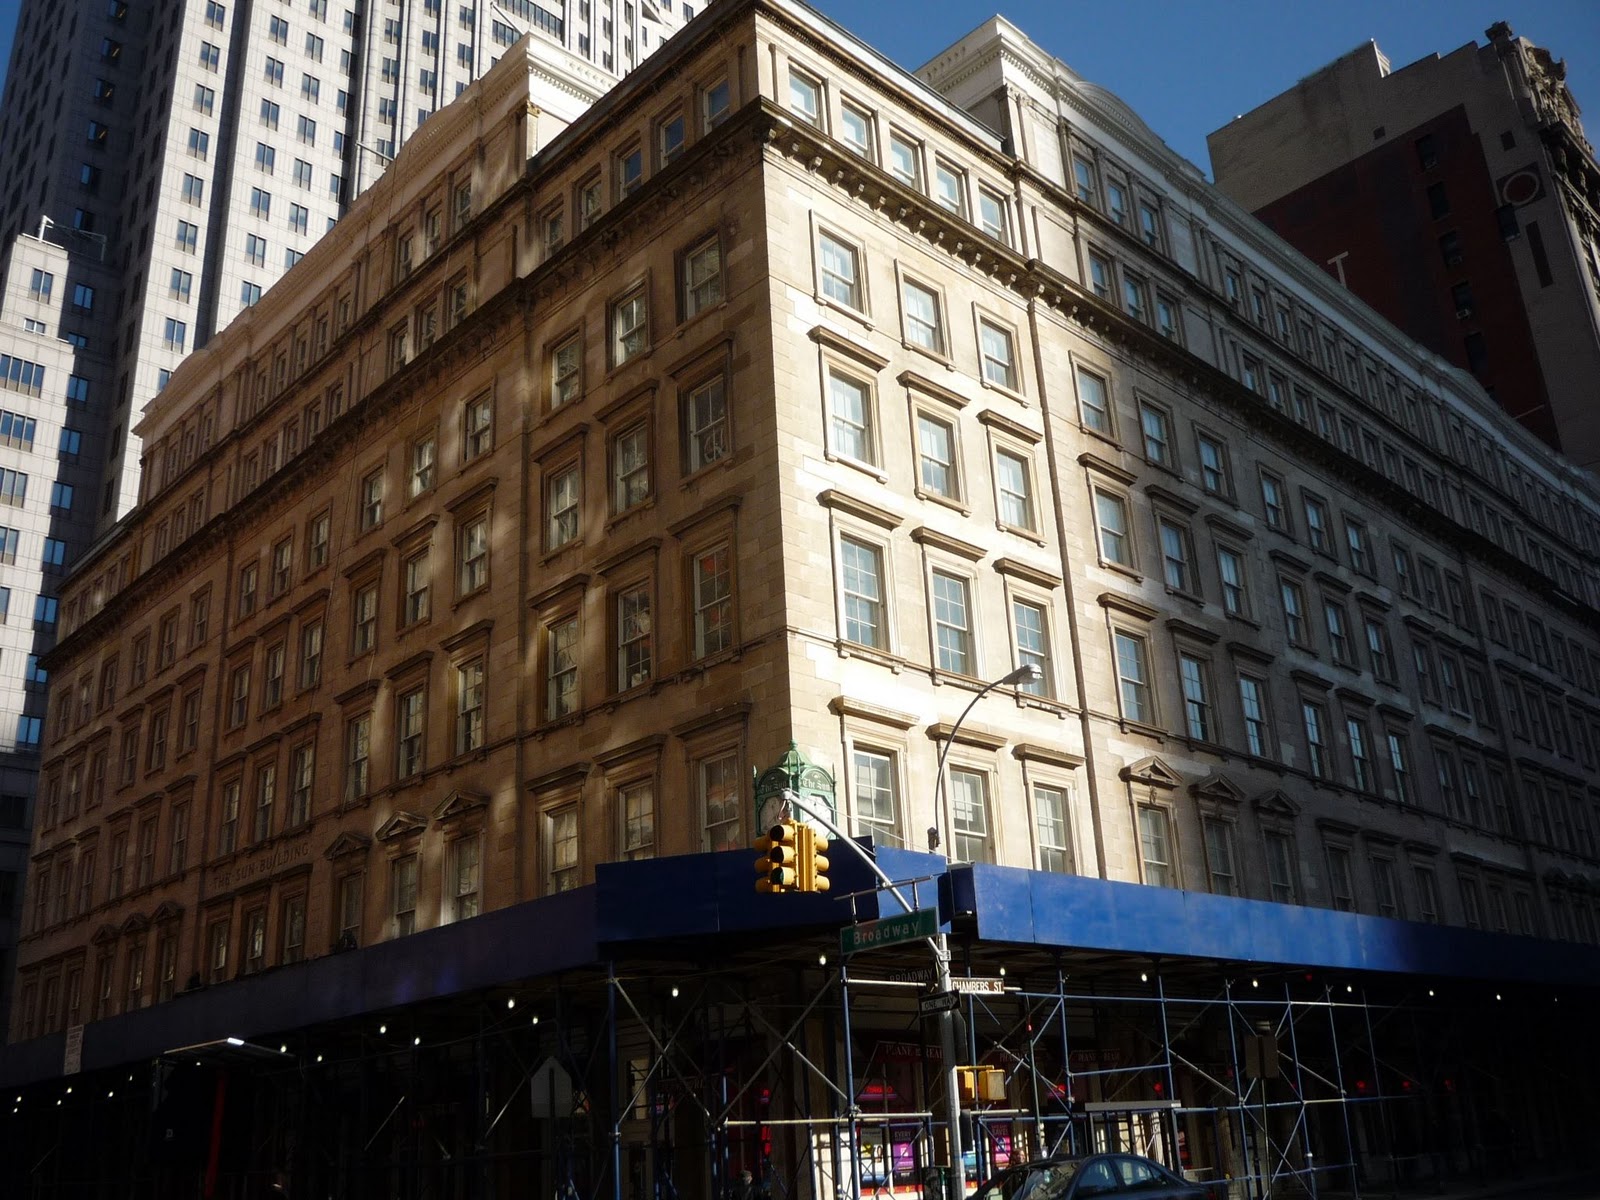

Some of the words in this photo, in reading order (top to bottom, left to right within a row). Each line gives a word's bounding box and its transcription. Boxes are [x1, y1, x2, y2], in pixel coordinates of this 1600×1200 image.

[802, 777, 815, 788] The
[213, 872, 231, 889] THE
[235, 863, 256, 882] SUN
[259, 842, 309, 873] BUILDING
[853, 921, 919, 944] Broadway
[889, 967, 933, 982] BROADWAY
[952, 980, 989, 992] CHAMBERS
[993, 980, 1002, 993] ST
[924, 1000, 937, 1009] ONE
[942, 995, 954, 1007] WAY
